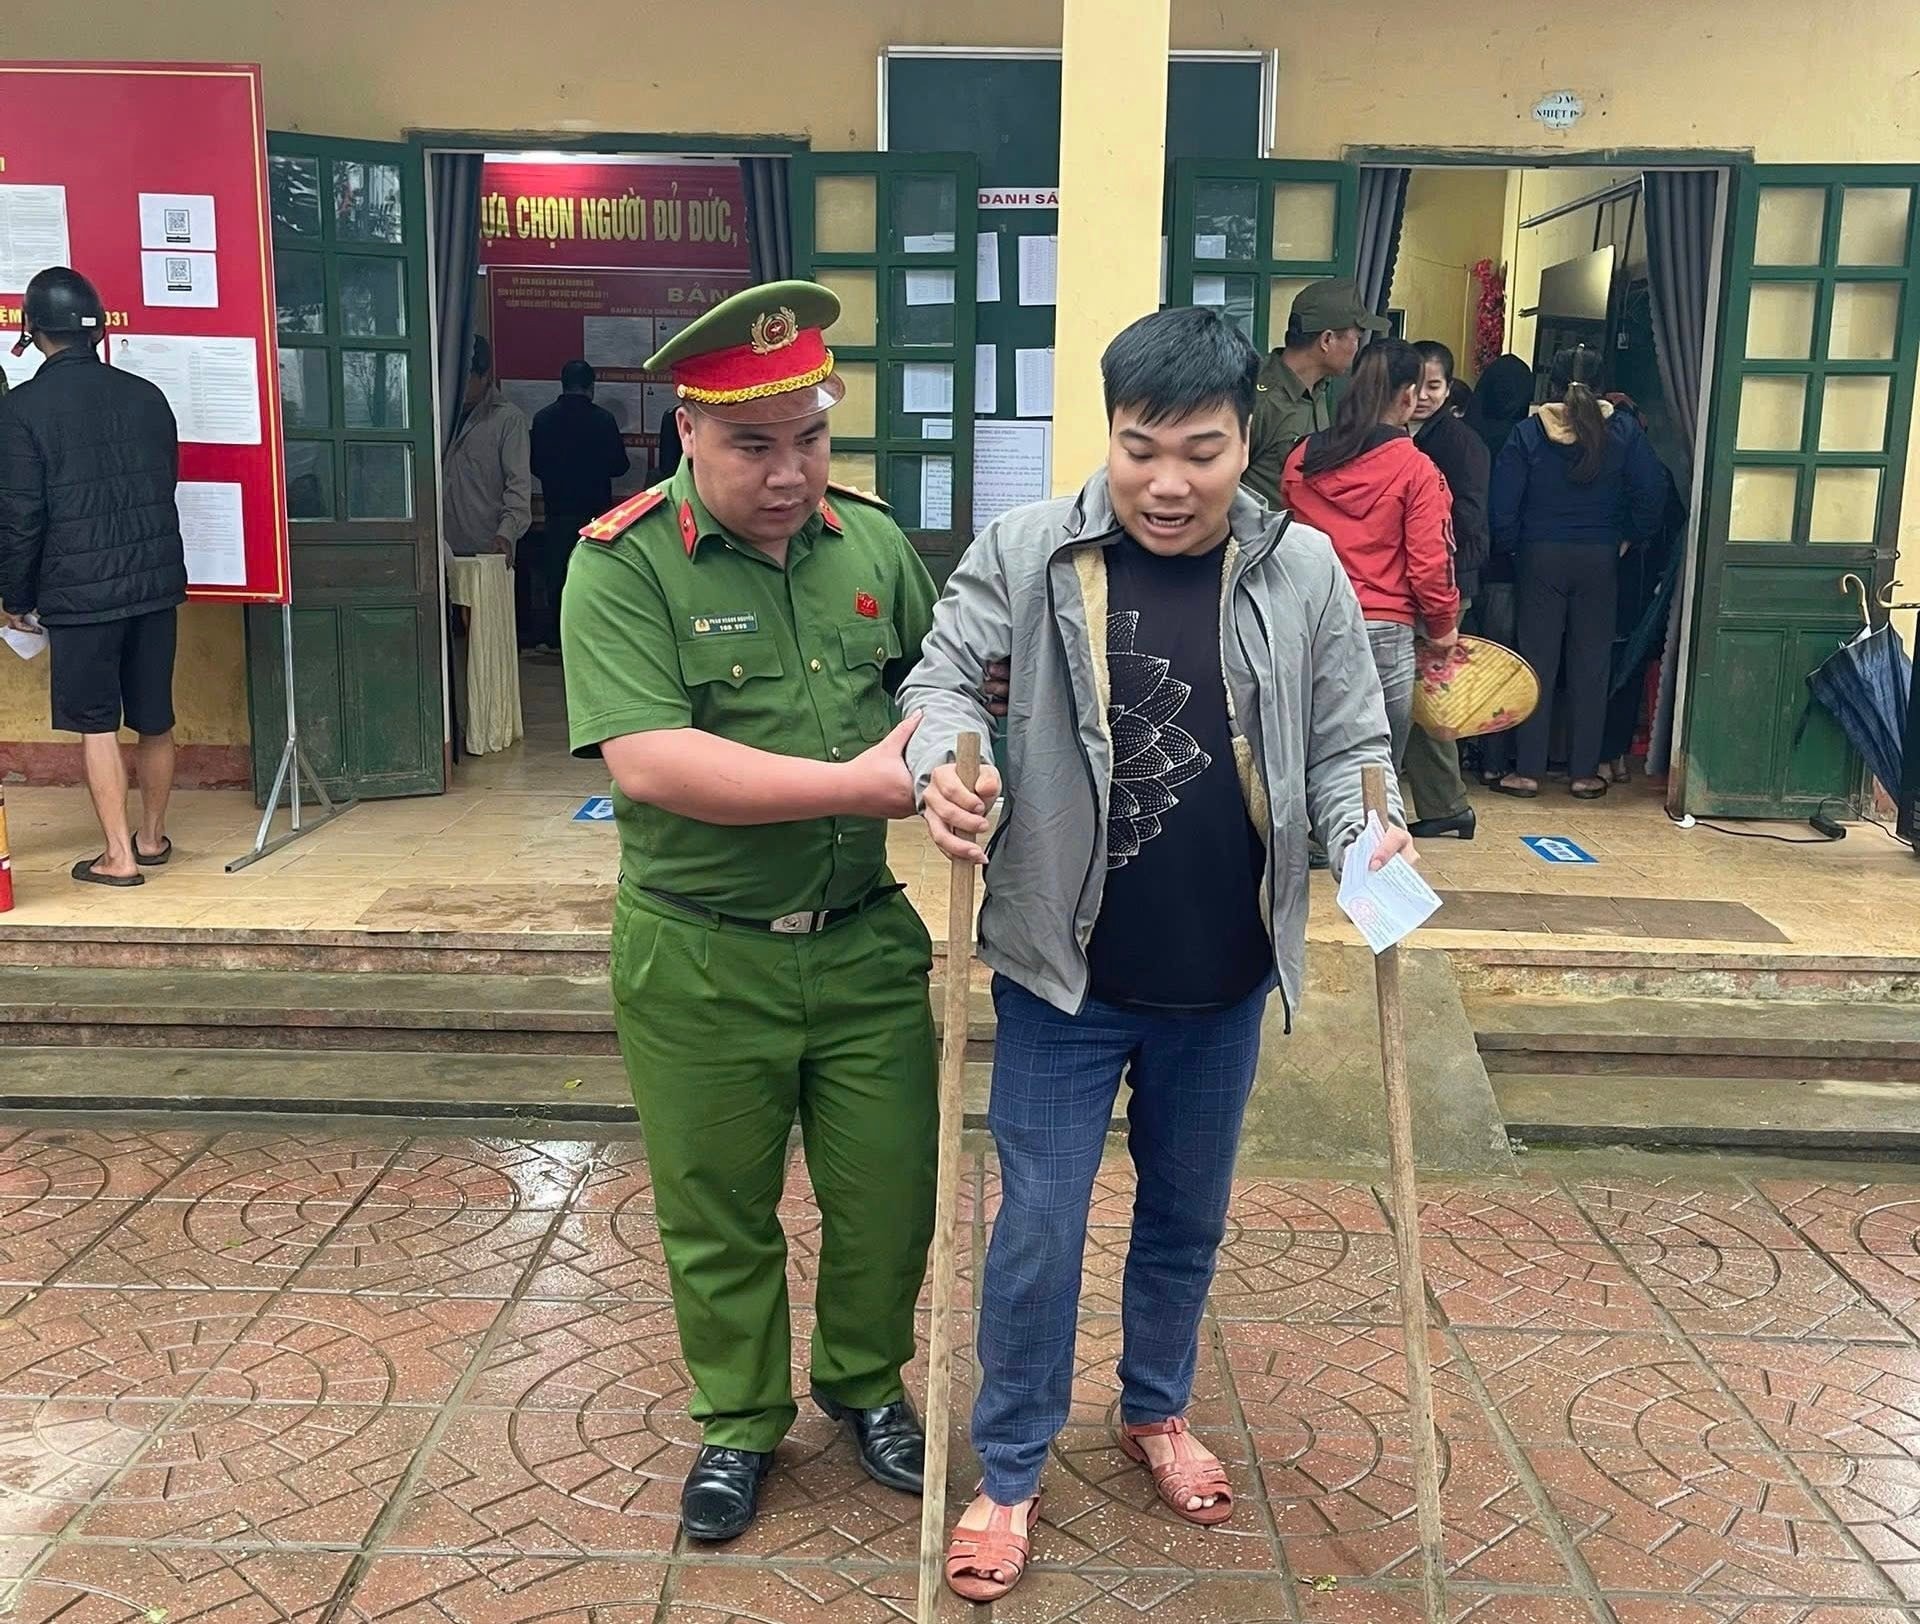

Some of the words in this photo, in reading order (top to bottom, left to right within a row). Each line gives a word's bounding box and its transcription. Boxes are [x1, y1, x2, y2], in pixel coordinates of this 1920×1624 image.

[515, 195, 575, 249] CHỌN
[581, 187, 648, 242] NGƯỜI
[653, 181, 683, 242] ĐỦ
[688, 187, 738, 248] ĐỨC,
[979, 193, 1031, 205] DANH
